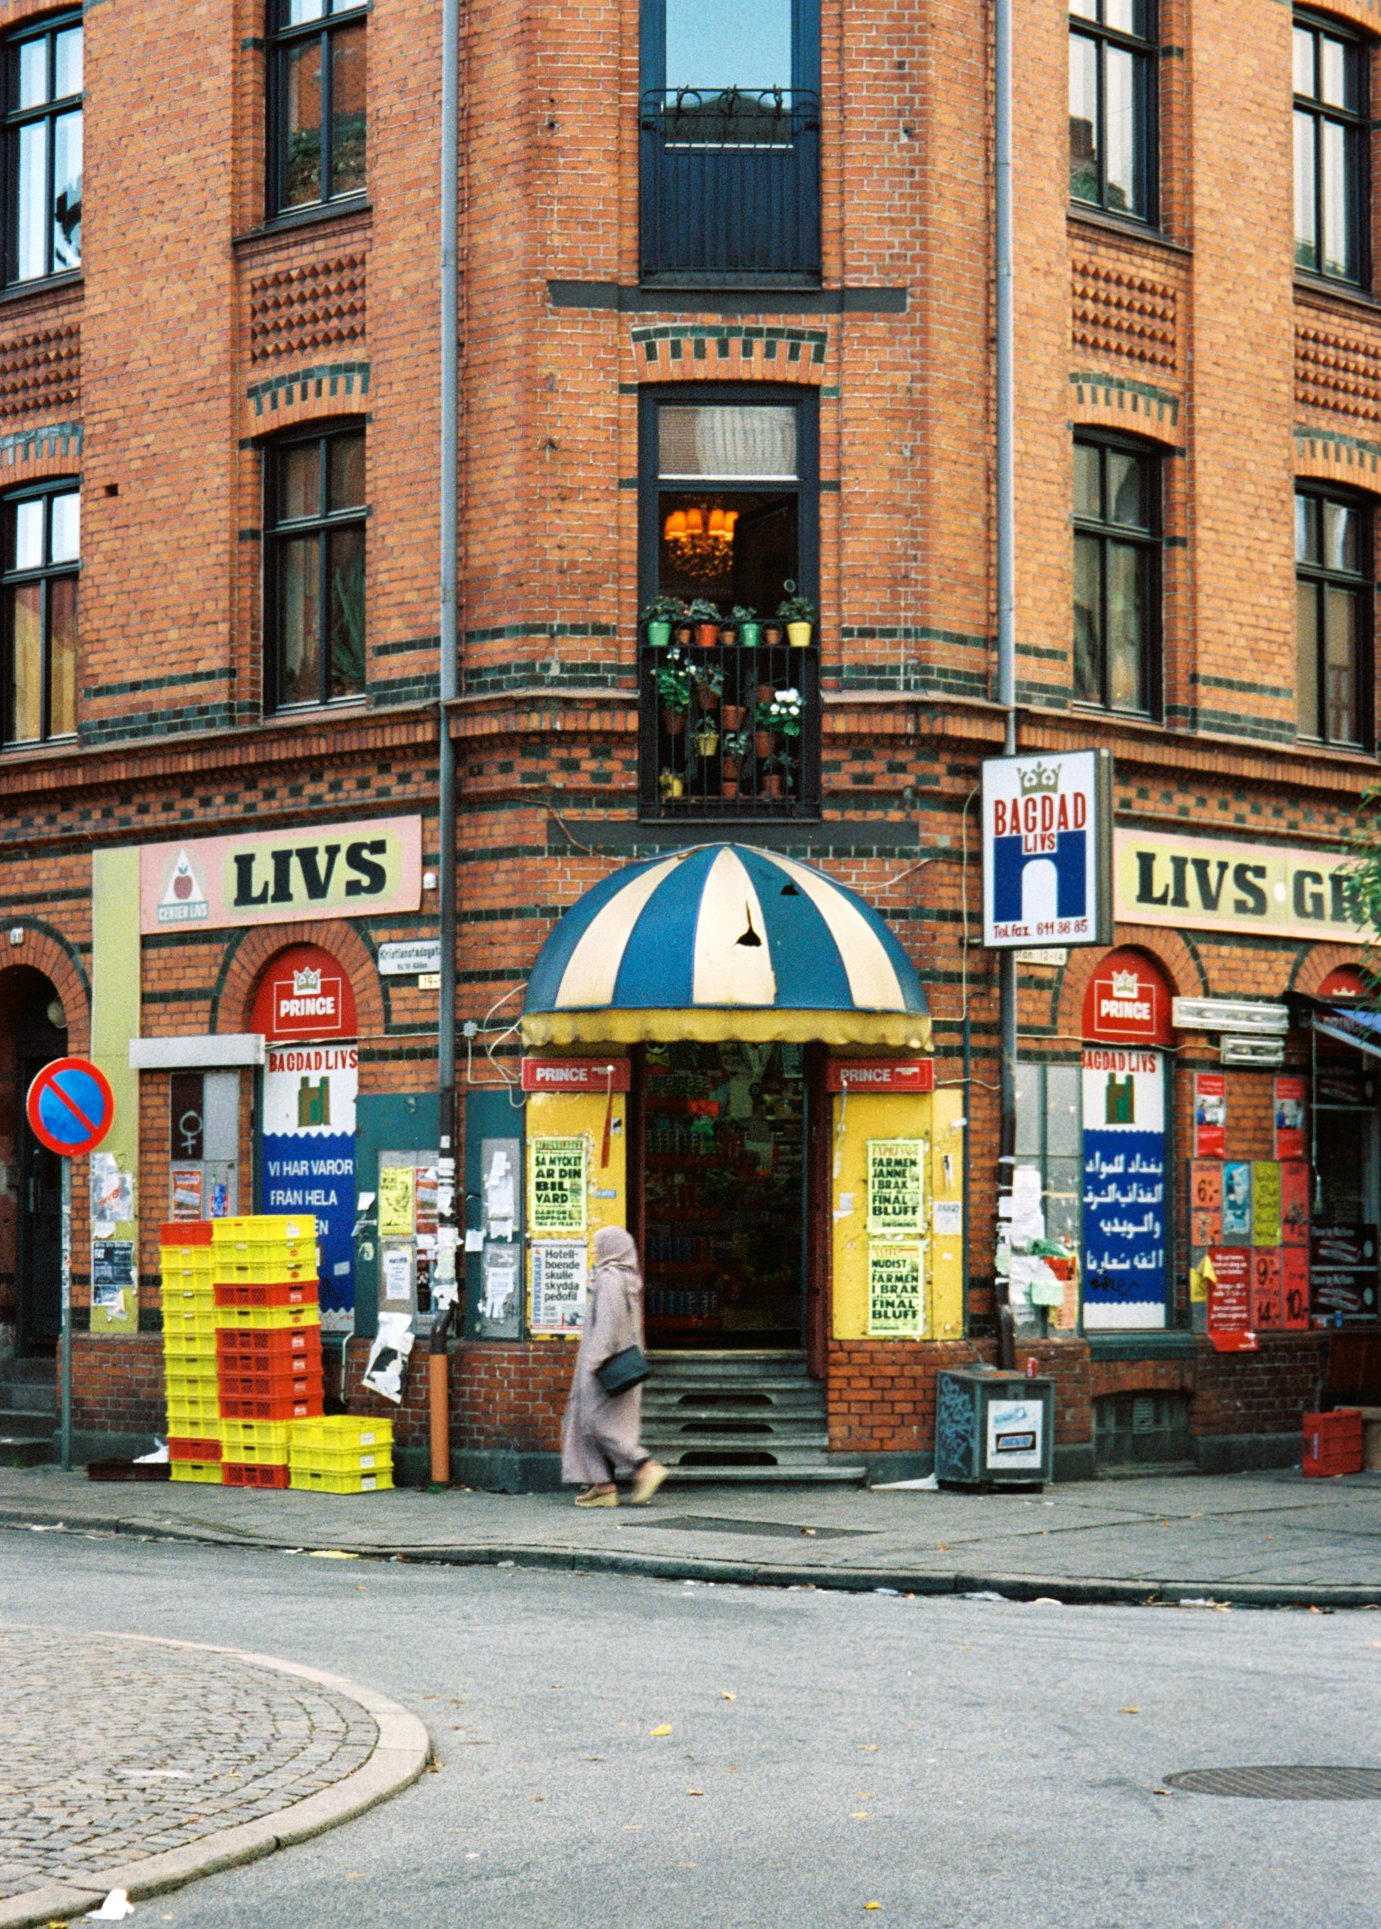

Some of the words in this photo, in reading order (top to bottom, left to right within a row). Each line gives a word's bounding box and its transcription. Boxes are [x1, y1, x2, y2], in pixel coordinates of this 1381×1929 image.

[994, 792, 1086, 836] BAGDAD
[1024, 832, 1056, 853] LIVS
[234, 839, 387, 907] LIVS
[1136, 851, 1267, 916] LIVS
[158, 905, 189, 921] CENTER
[190, 903, 208, 918] LIVS
[280, 996, 335, 1017] PRINCE
[1101, 999, 1151, 1020] PRINCE
[269, 1051, 322, 1073] BAGDAD
[325, 1049, 358, 1069] LIVS
[1081, 1049, 1126, 1071] BAGDAD
[1128, 1052, 1156, 1073] LIVS
[536, 1067, 588, 1081] PRINCE
[840, 1068, 891, 1082] PRINCE
[268, 1161, 281, 1176] VI
[283, 1160, 309, 1176] HAR
[311, 1159, 353, 1176] VAROR
[548, 1155, 582, 1167] MYCKET
[558, 1168, 582, 1179] DIN
[872, 1168, 907, 1179] JANNE
[535, 1181, 568, 1191] BIL
[270, 1187, 302, 1206] FRÅN
[305, 1189, 338, 1206] HELA
[872, 1205, 918, 1216] BLUFF
[545, 1249, 579, 1259] Hotell-
[545, 1261, 580, 1270] boende
[545, 1271, 574, 1280] skulle
[872, 1273, 919, 1284] FARMEN
[545, 1282, 580, 1293] skydda
[545, 1292, 577, 1303] pedofil
[872, 1309, 919, 1320] BLUFF
